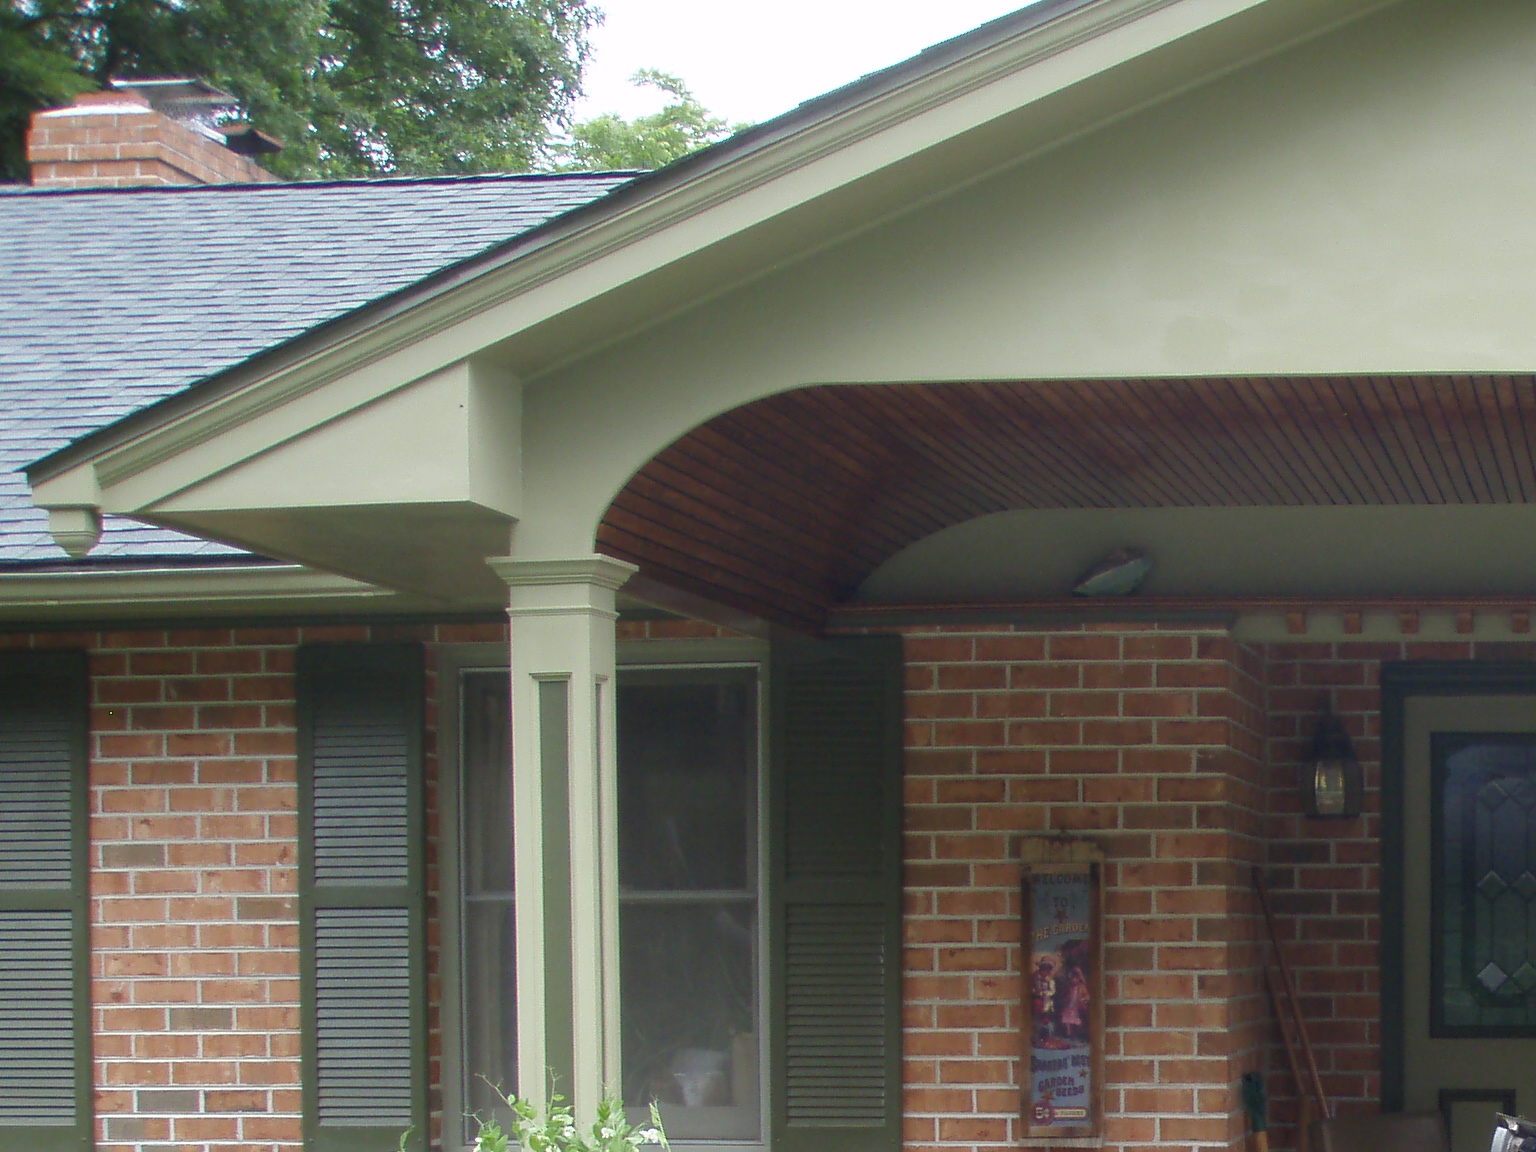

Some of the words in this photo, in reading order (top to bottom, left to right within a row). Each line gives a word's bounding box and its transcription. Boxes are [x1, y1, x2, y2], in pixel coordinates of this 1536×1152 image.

[1053, 896, 1068, 908] TO
[1031, 926, 1051, 942] THE
[1053, 922, 1090, 935] GARDEN
[1038, 1076, 1075, 1093] GARDEN
[1055, 1084, 1085, 1097] SEEDS
